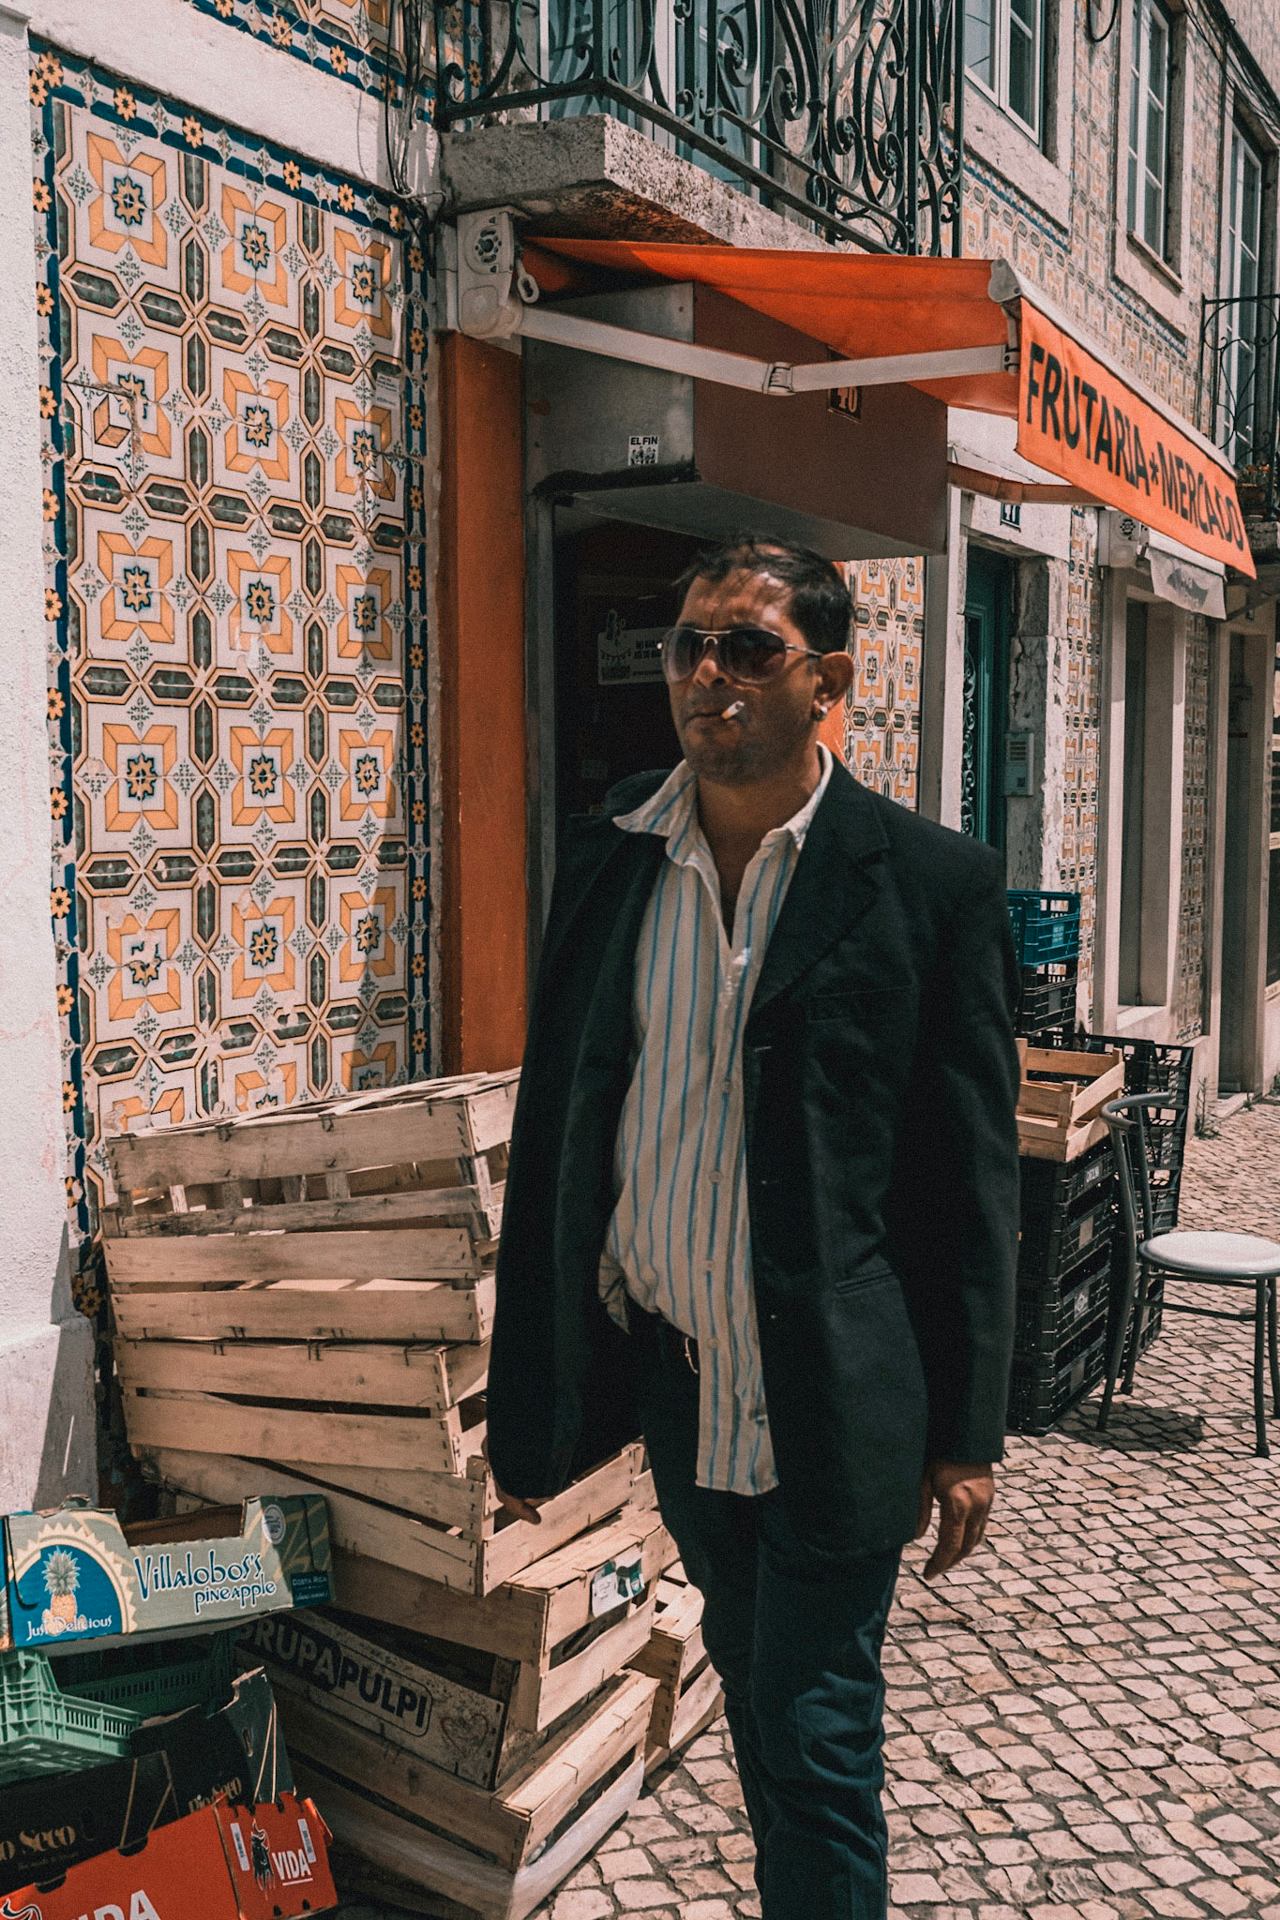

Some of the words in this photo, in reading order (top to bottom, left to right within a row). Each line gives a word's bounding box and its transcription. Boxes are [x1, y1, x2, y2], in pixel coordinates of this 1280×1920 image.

[630, 437, 641, 446] EL
[642, 436, 658, 445] FIN
[1026, 342, 1150, 496] FRUTARIA
[1156, 441, 1245, 551] MERCADO
[195, 1573, 276, 1615] pineapple
[25, 1617, 49, 1642] Just
[54, 1614, 113, 1633] Delicious
[271, 1848, 312, 1881] VIDA
